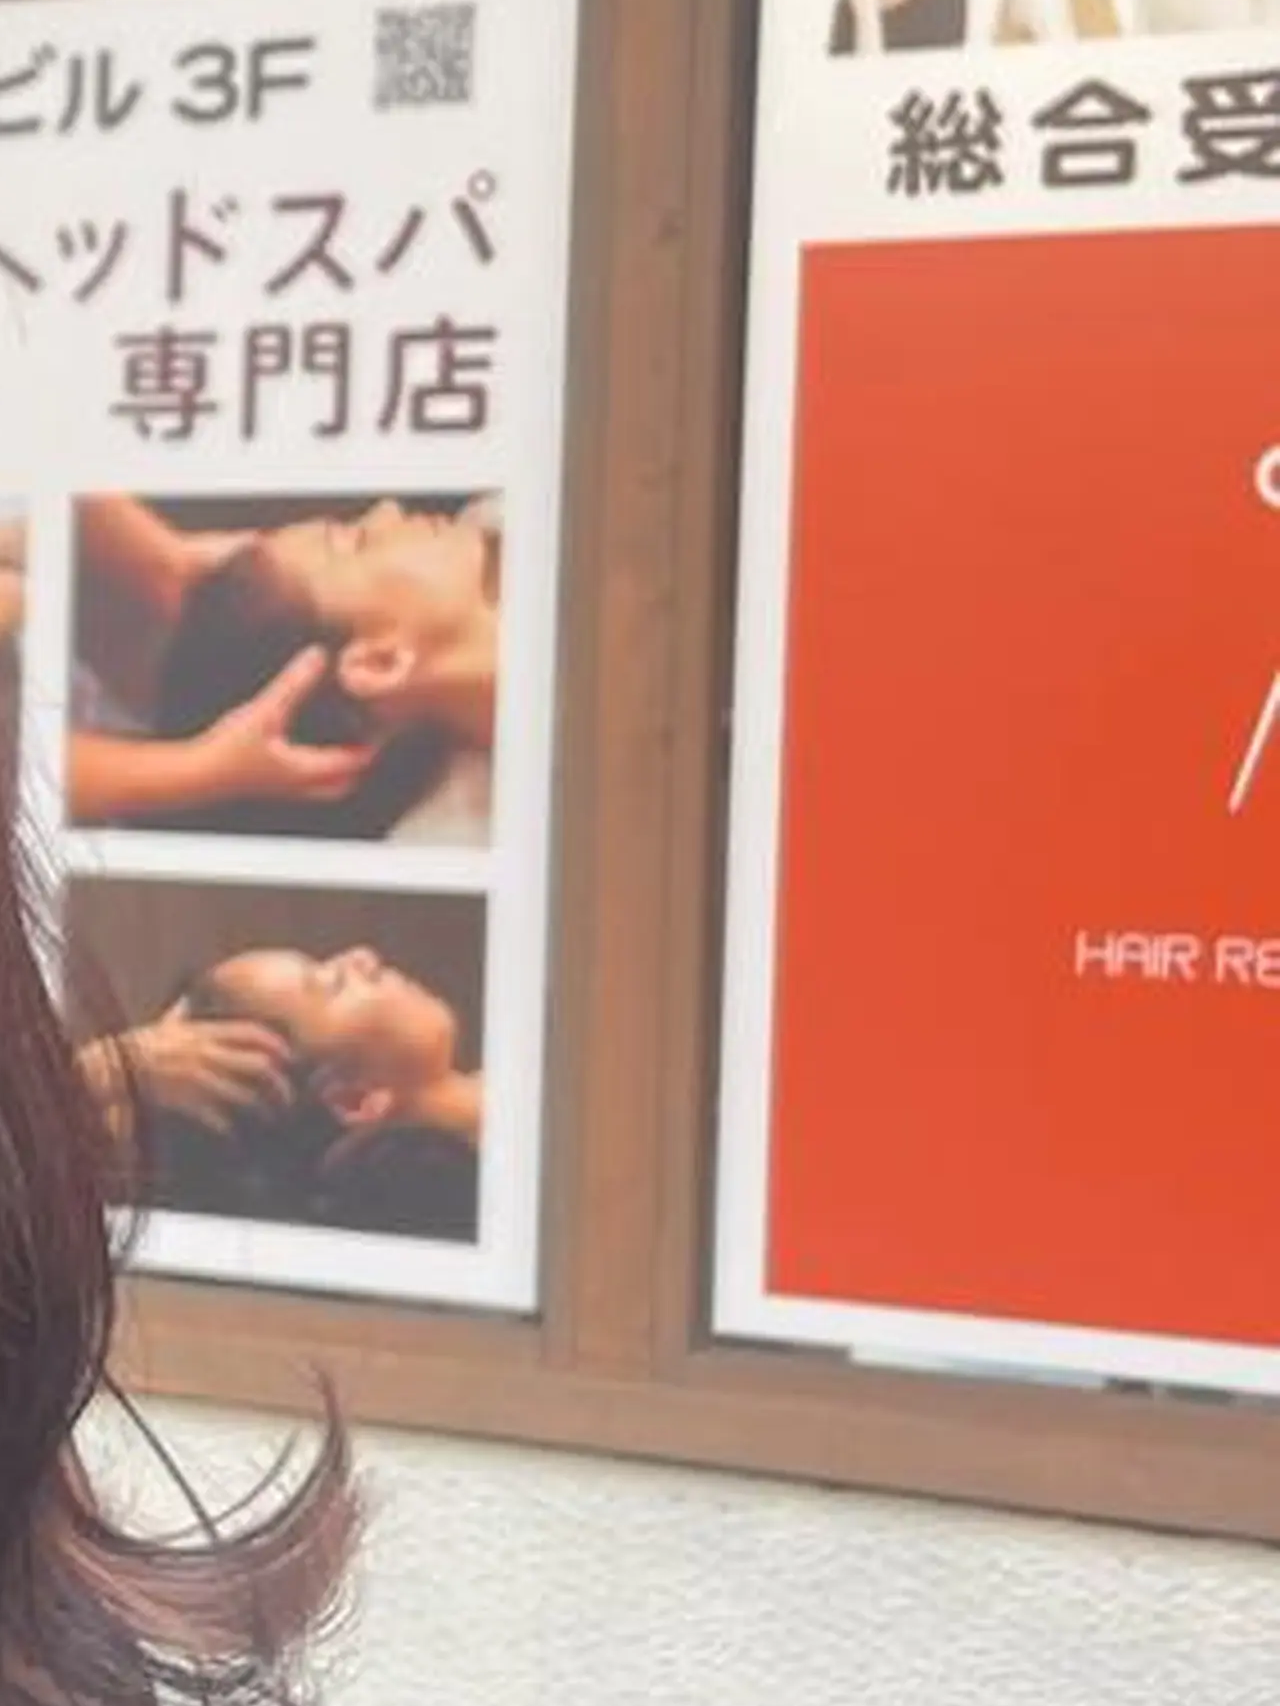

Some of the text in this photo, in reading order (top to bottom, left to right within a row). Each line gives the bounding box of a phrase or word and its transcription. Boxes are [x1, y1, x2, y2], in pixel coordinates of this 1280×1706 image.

[168, 35, 318, 127] 3F
[108, 313, 498, 443] 専門店
[1074, 929, 1200, 983] HAIR
